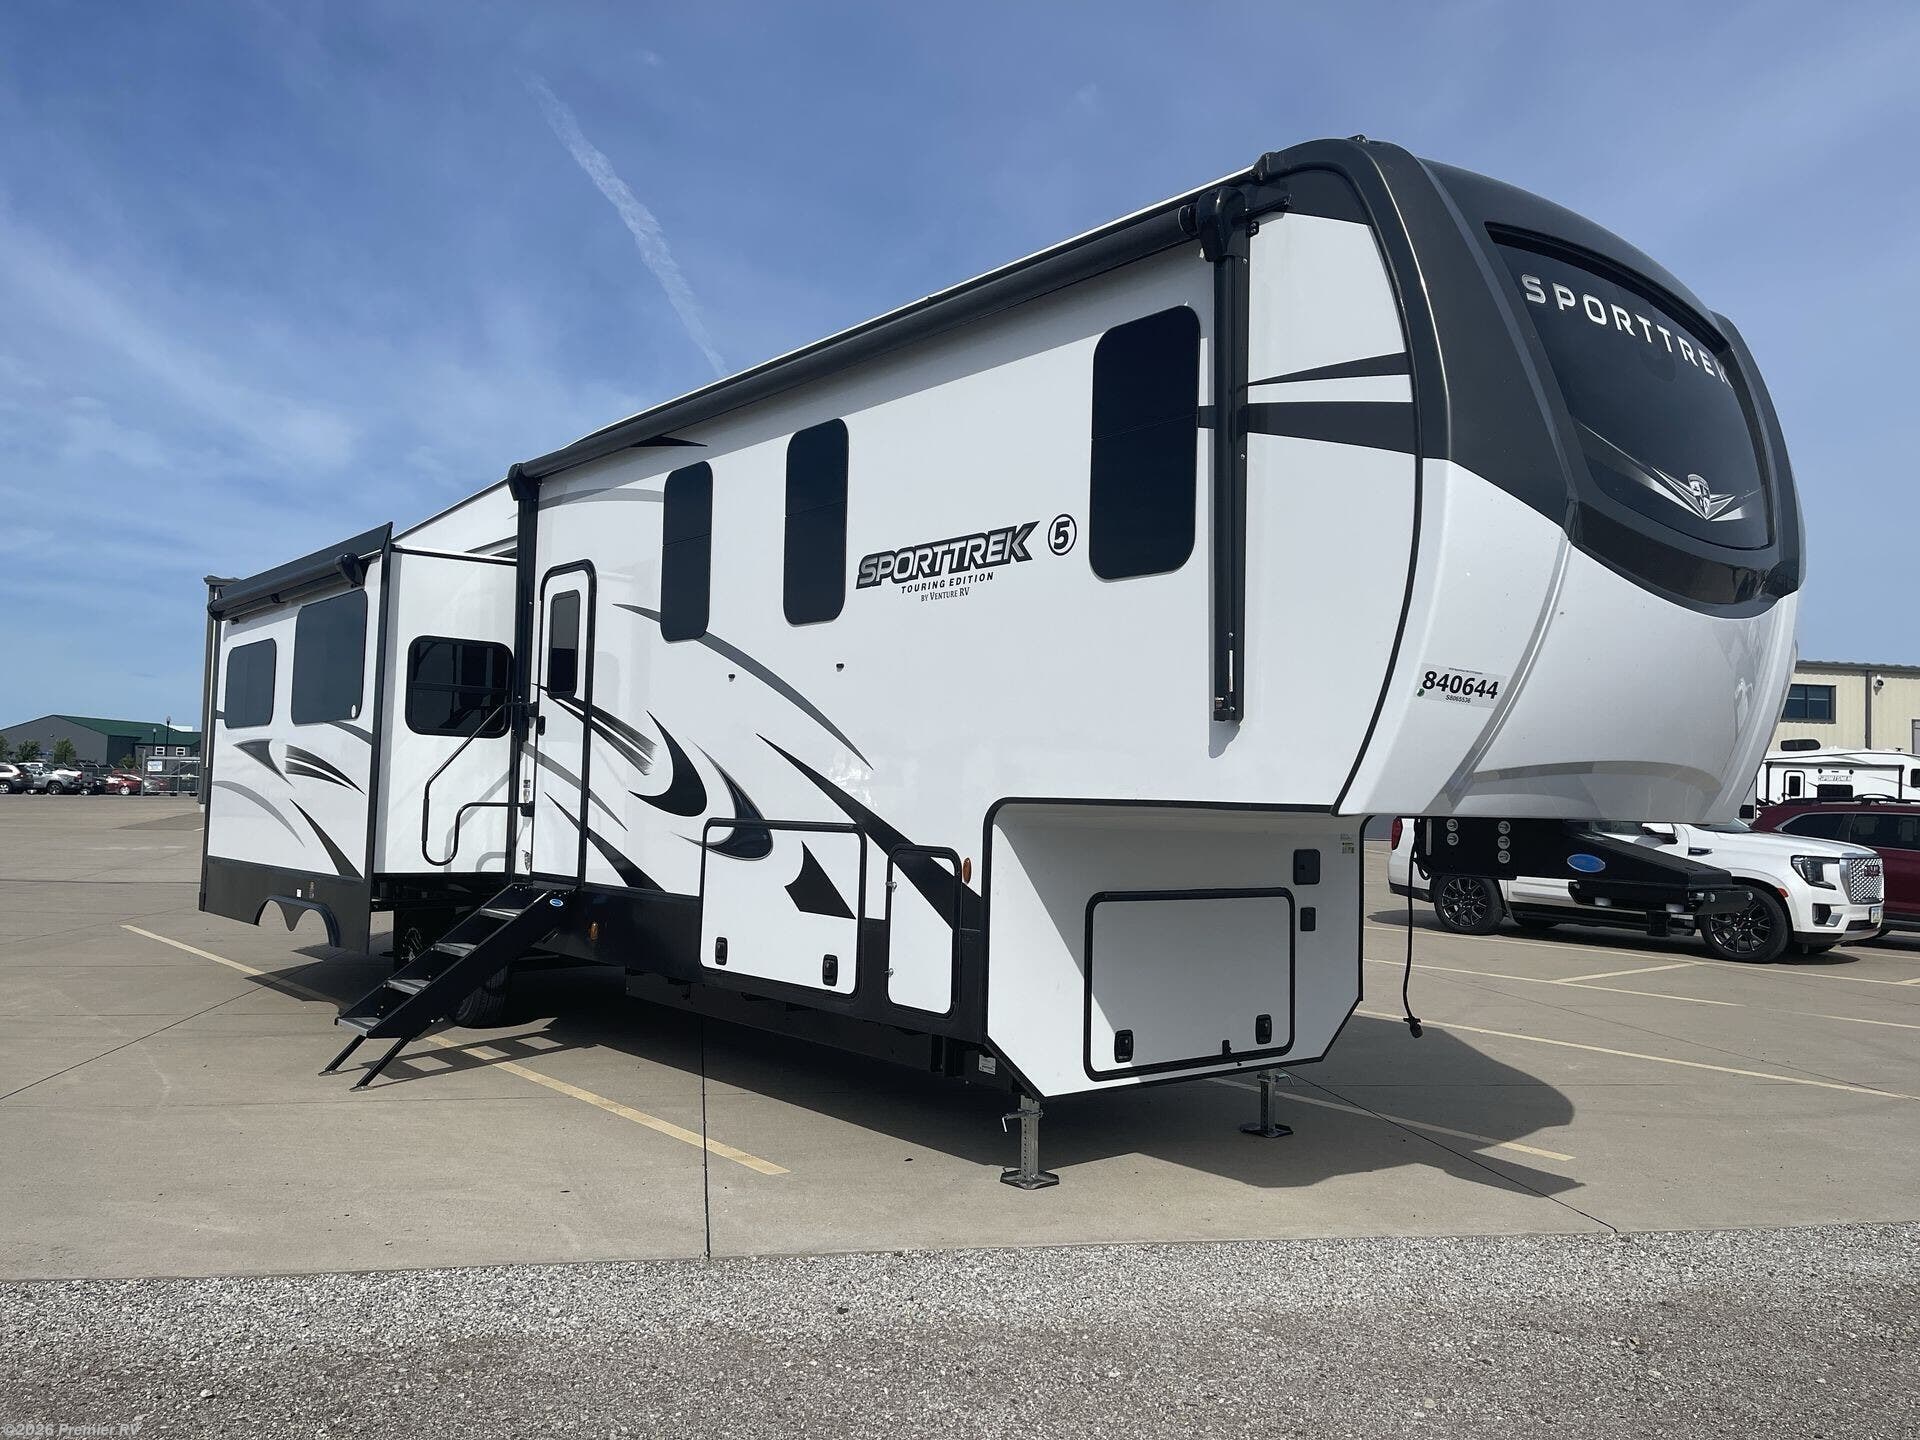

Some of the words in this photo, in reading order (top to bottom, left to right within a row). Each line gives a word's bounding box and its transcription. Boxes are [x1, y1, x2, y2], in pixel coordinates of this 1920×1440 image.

[1521, 273, 1734, 389] SPORTTREK
[1053, 520, 1071, 550] 5
[856, 521, 1041, 589] SPORTTREK
[901, 580, 945, 594] TOURING
[949, 572, 994, 586] EDITION
[921, 594, 929, 602] BY
[959, 587, 970, 597] RV
[1422, 670, 1499, 699] 840644
